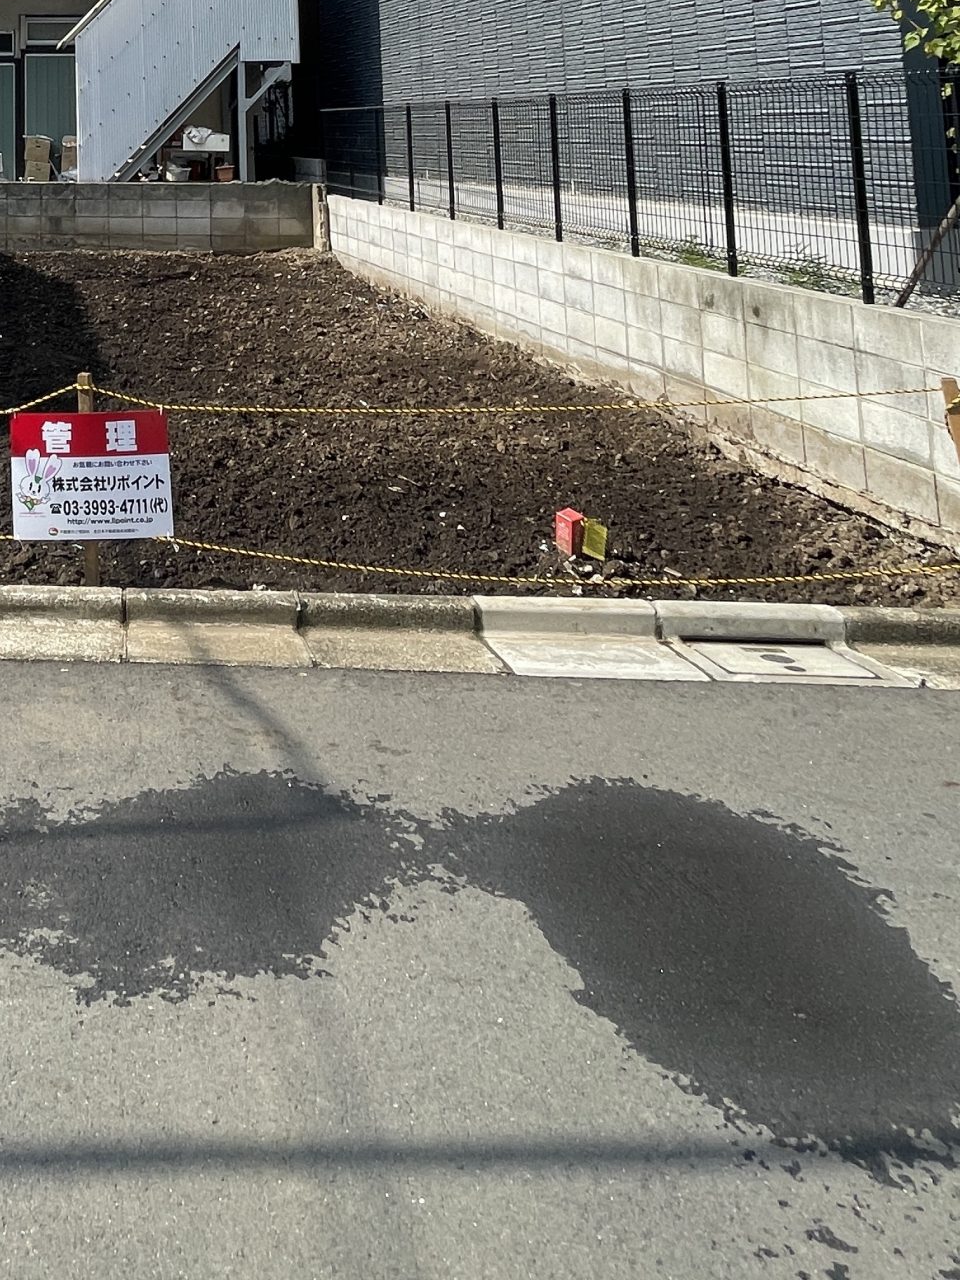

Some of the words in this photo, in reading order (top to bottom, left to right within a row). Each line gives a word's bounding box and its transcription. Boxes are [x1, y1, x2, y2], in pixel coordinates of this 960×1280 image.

[42, 421, 138, 453] 管理
[53, 474, 164, 492] 株式会社リポイント
